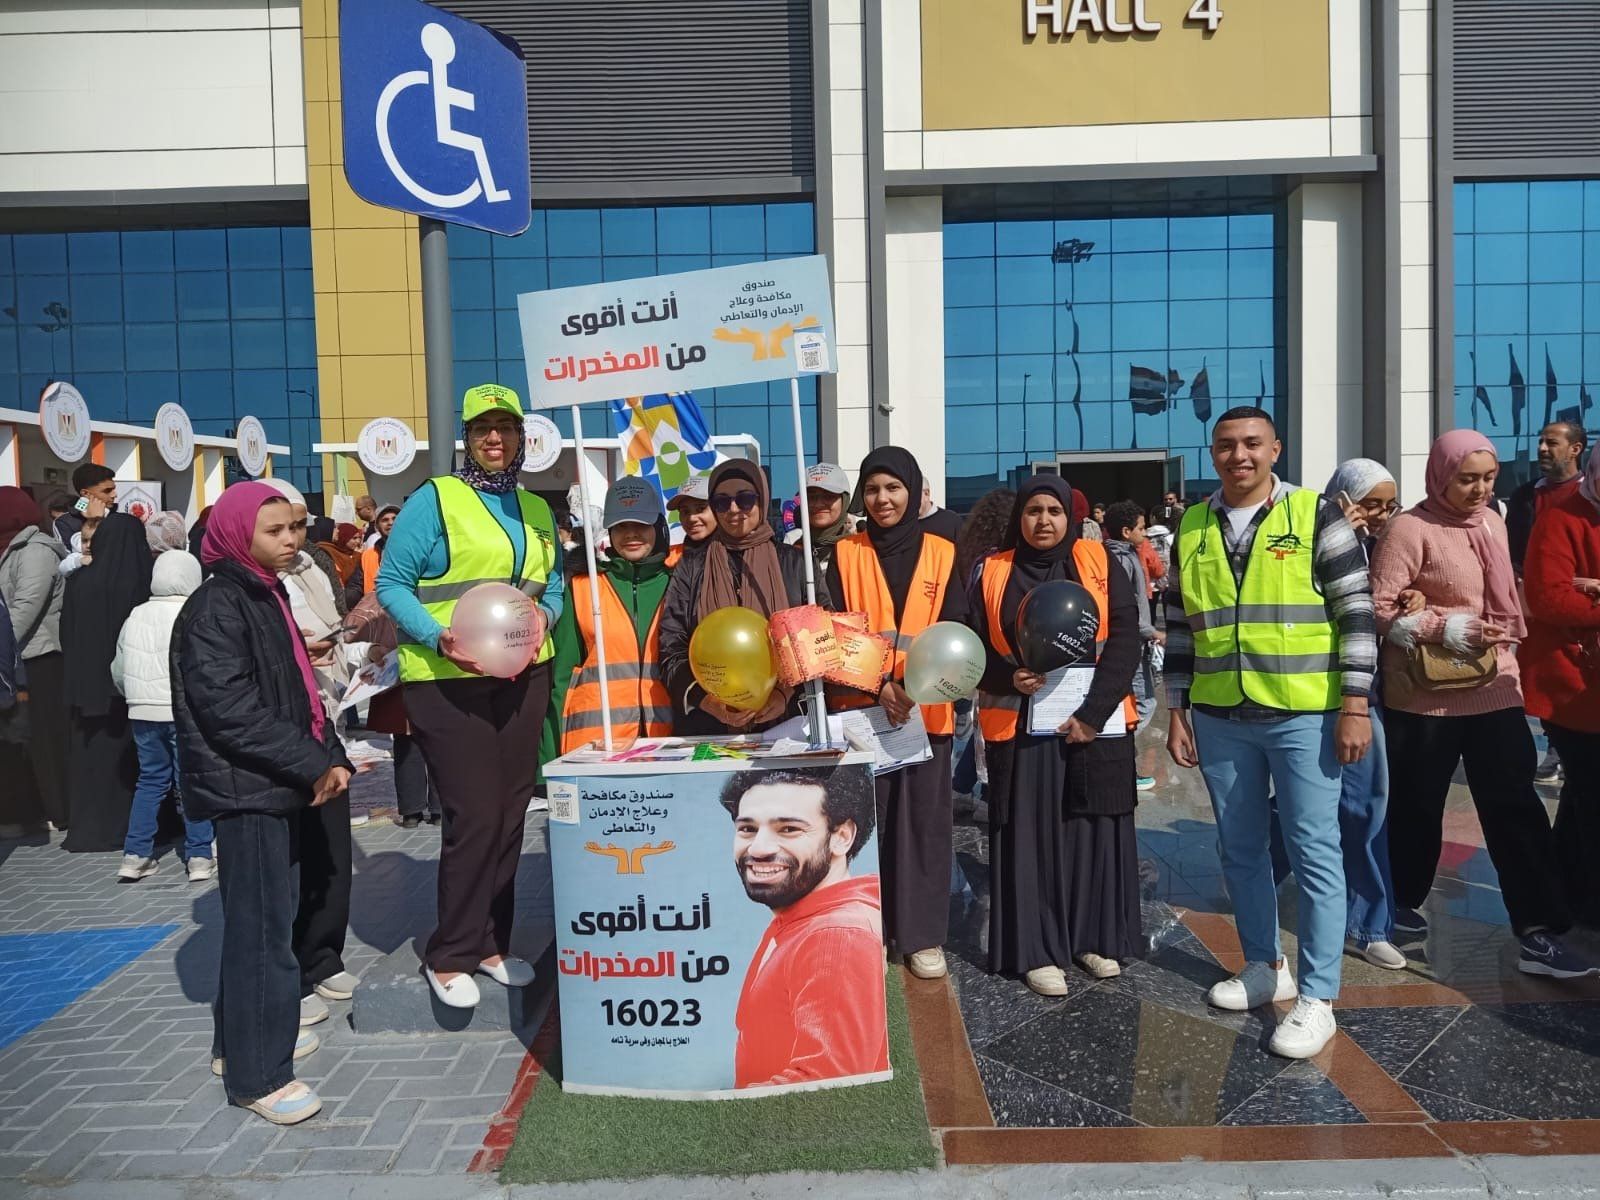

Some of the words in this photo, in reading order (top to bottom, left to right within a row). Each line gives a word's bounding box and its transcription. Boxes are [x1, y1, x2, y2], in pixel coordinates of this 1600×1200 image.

[1026, 0, 1162, 35] HALL
[1187, 0, 1224, 31] 4
[741, 279, 776, 292] صندوق
[756, 291, 792, 303] مكافحة
[631, 290, 679, 324] أنت
[729, 296, 755, 309] وعلاج
[770, 303, 804, 318] الإدمان
[560, 297, 626, 337] أقوى
[720, 308, 768, 324] والتعاطي
[543, 345, 660, 383] المخدرات
[665, 342, 707, 371] من
[503, 628, 531, 641] 16023
[1056, 632, 1081, 649] 16023
[580, 789, 627, 801] مكافحة
[628, 789, 674, 804] صندوق
[631, 806, 669, 821] وعلاج
[571, 894, 647, 938] أقوى
[652, 892, 711, 932] أنت
[558, 949, 675, 983] المخدرات
[681, 950, 730, 983] من
[601, 998, 702, 1027] 16023
